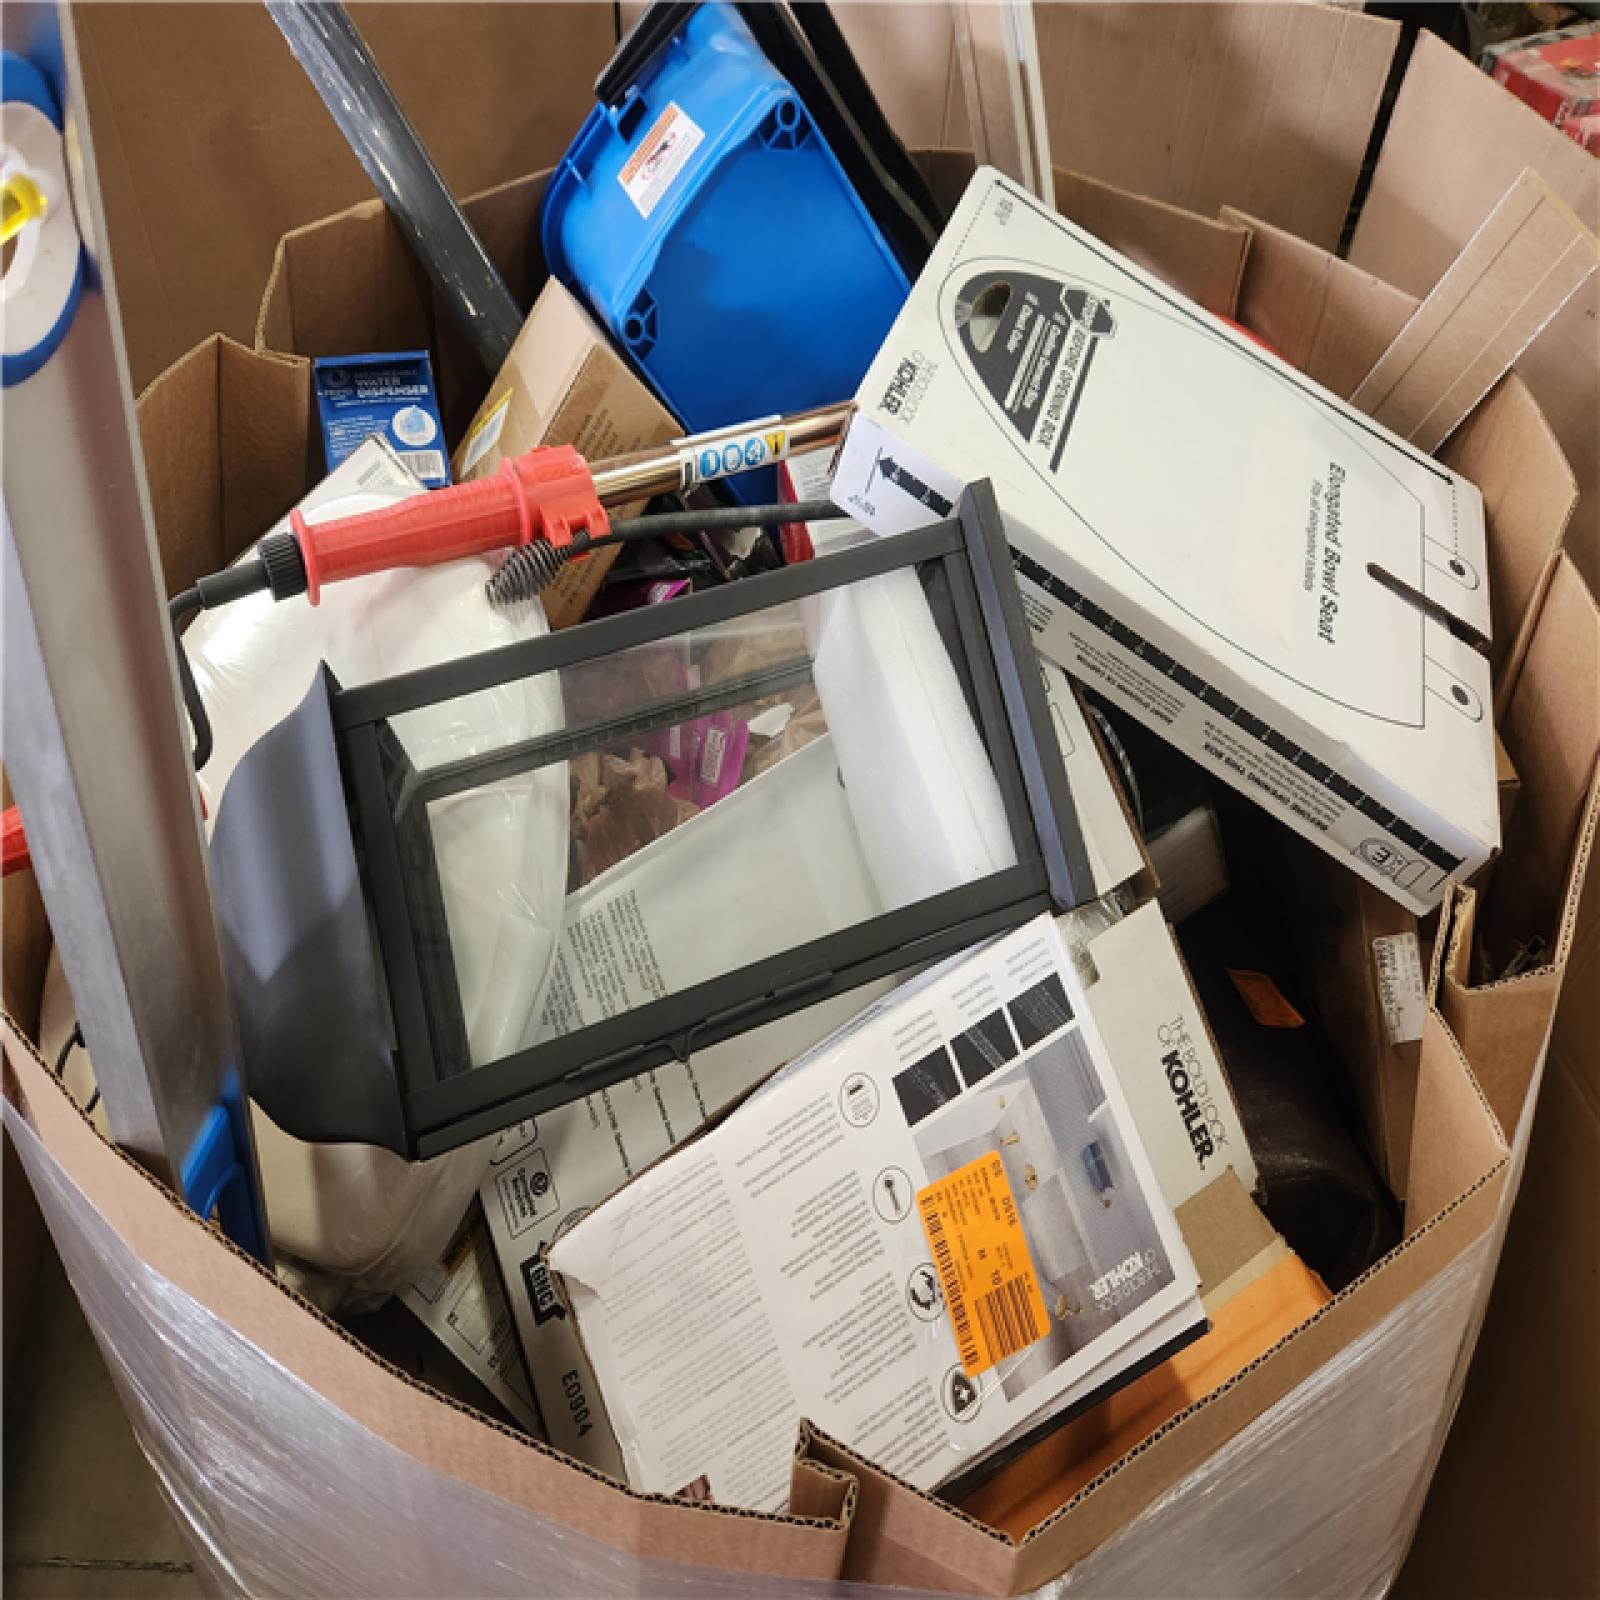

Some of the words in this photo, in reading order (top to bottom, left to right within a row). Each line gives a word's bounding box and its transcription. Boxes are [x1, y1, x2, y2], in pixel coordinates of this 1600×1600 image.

[354, 376, 401, 386] WATER
[356, 384, 429, 399] DISPENSER
[1325, 462, 1346, 547] Elongated
[1322, 547, 1341, 597] Bowl
[1317, 595, 1338, 645] Seat
